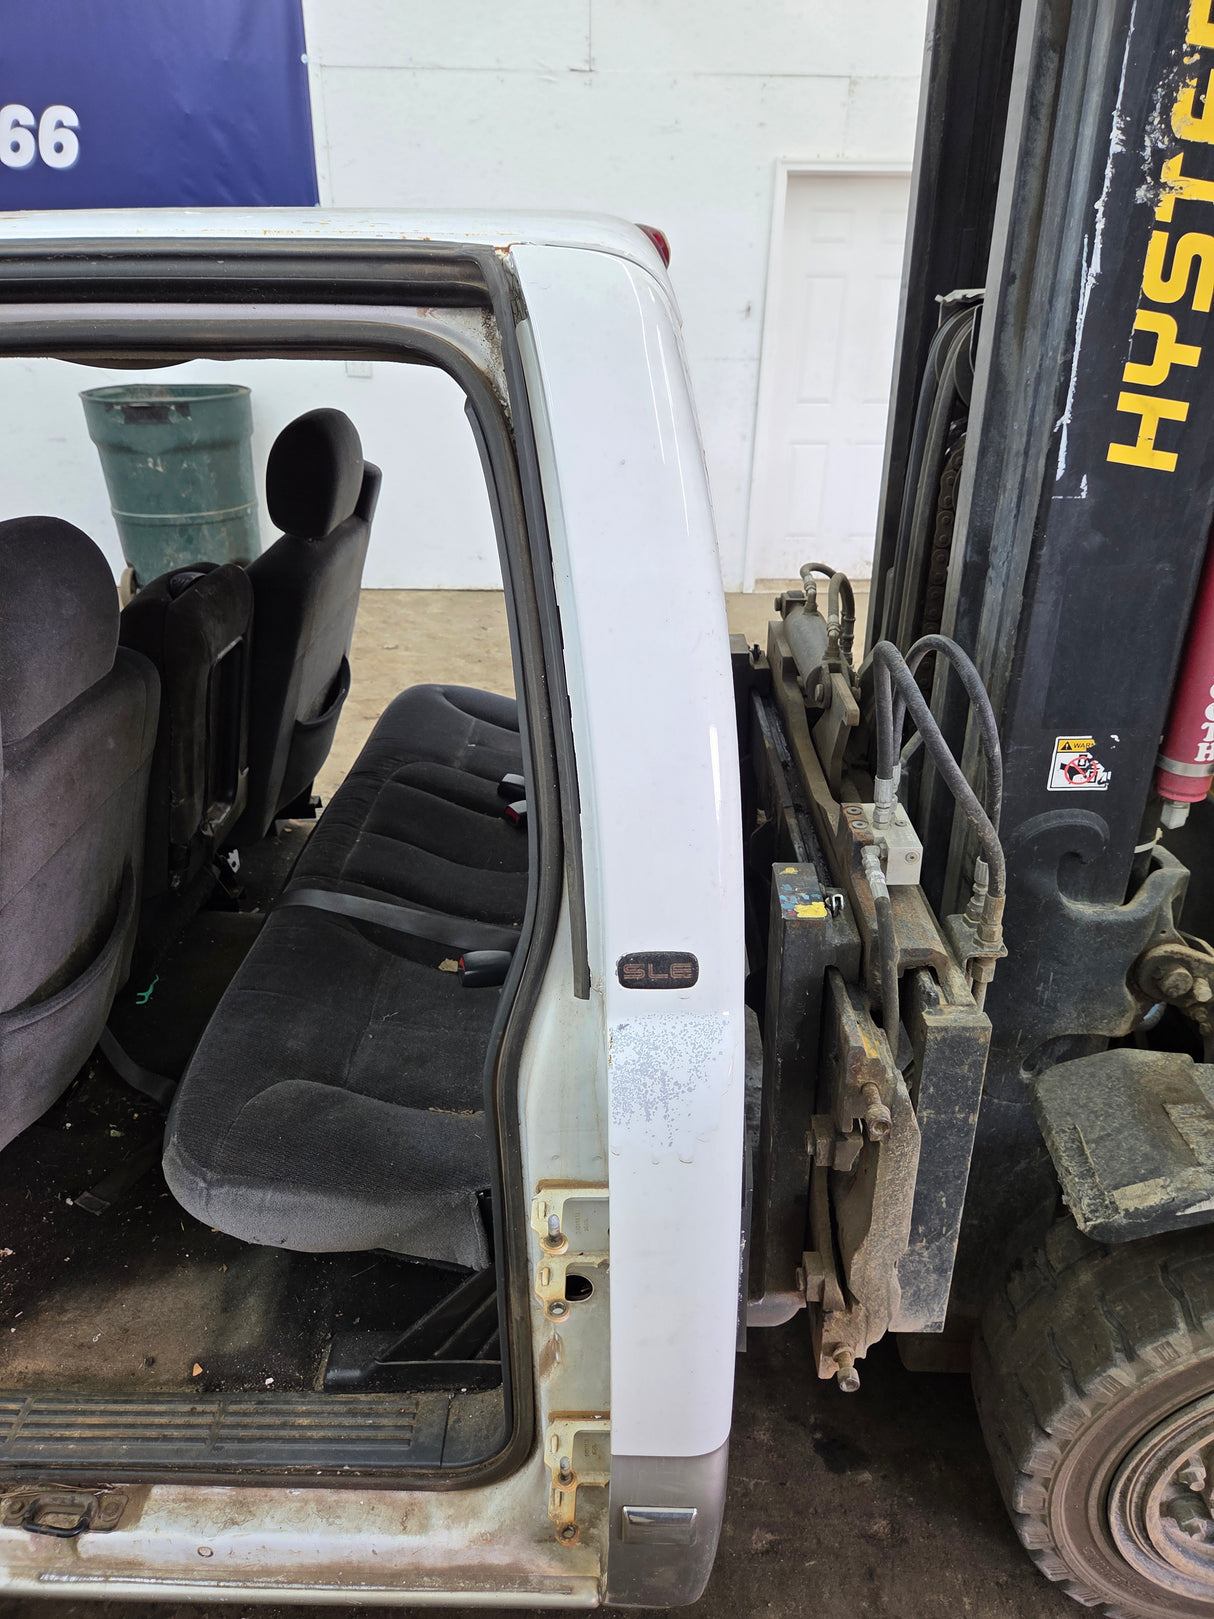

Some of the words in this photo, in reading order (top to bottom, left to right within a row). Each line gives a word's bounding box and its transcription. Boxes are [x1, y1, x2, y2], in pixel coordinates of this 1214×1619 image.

[0, 104, 80, 169] 66
[1106, 0, 1214, 472] HYSTE
[623, 962, 692, 979] SLE
